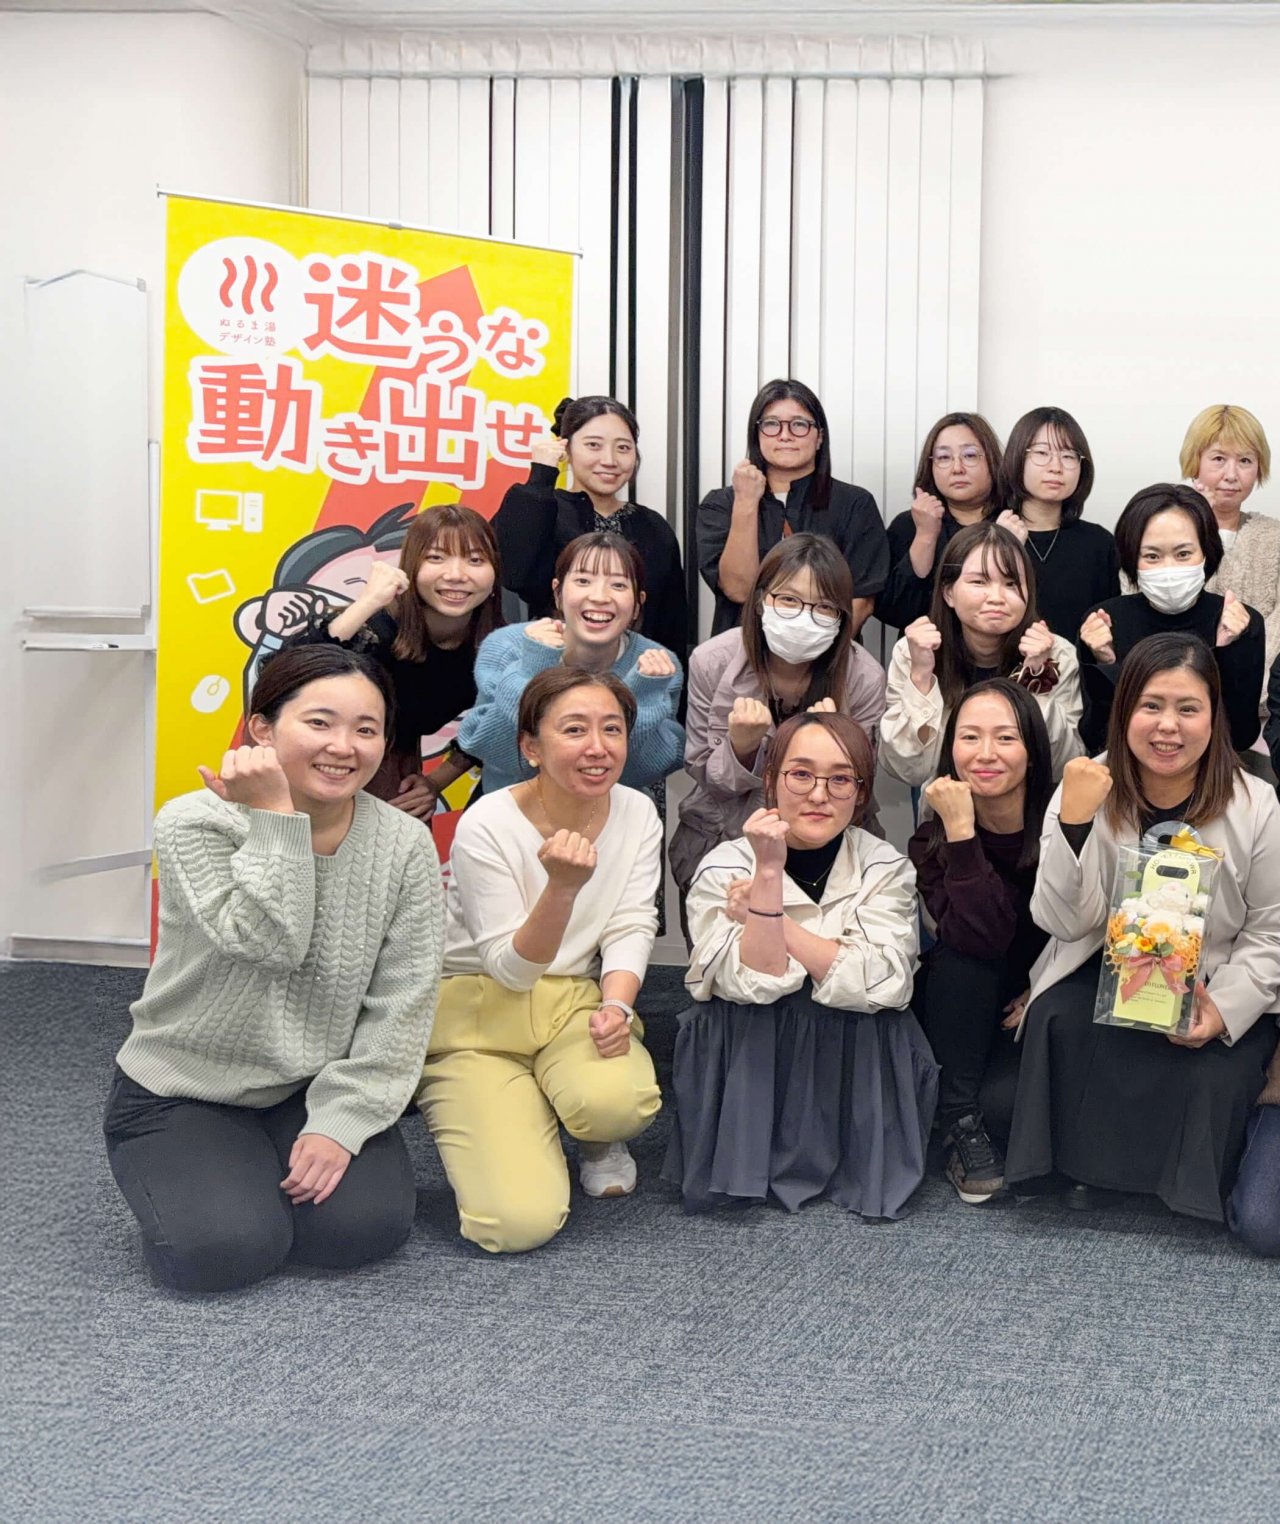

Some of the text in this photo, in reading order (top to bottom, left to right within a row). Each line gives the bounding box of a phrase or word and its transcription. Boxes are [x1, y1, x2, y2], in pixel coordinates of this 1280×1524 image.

[218, 332, 277, 347] デザイン塾
[303, 261, 540, 373] 迷うな
[197, 362, 543, 480] 動き出せ
